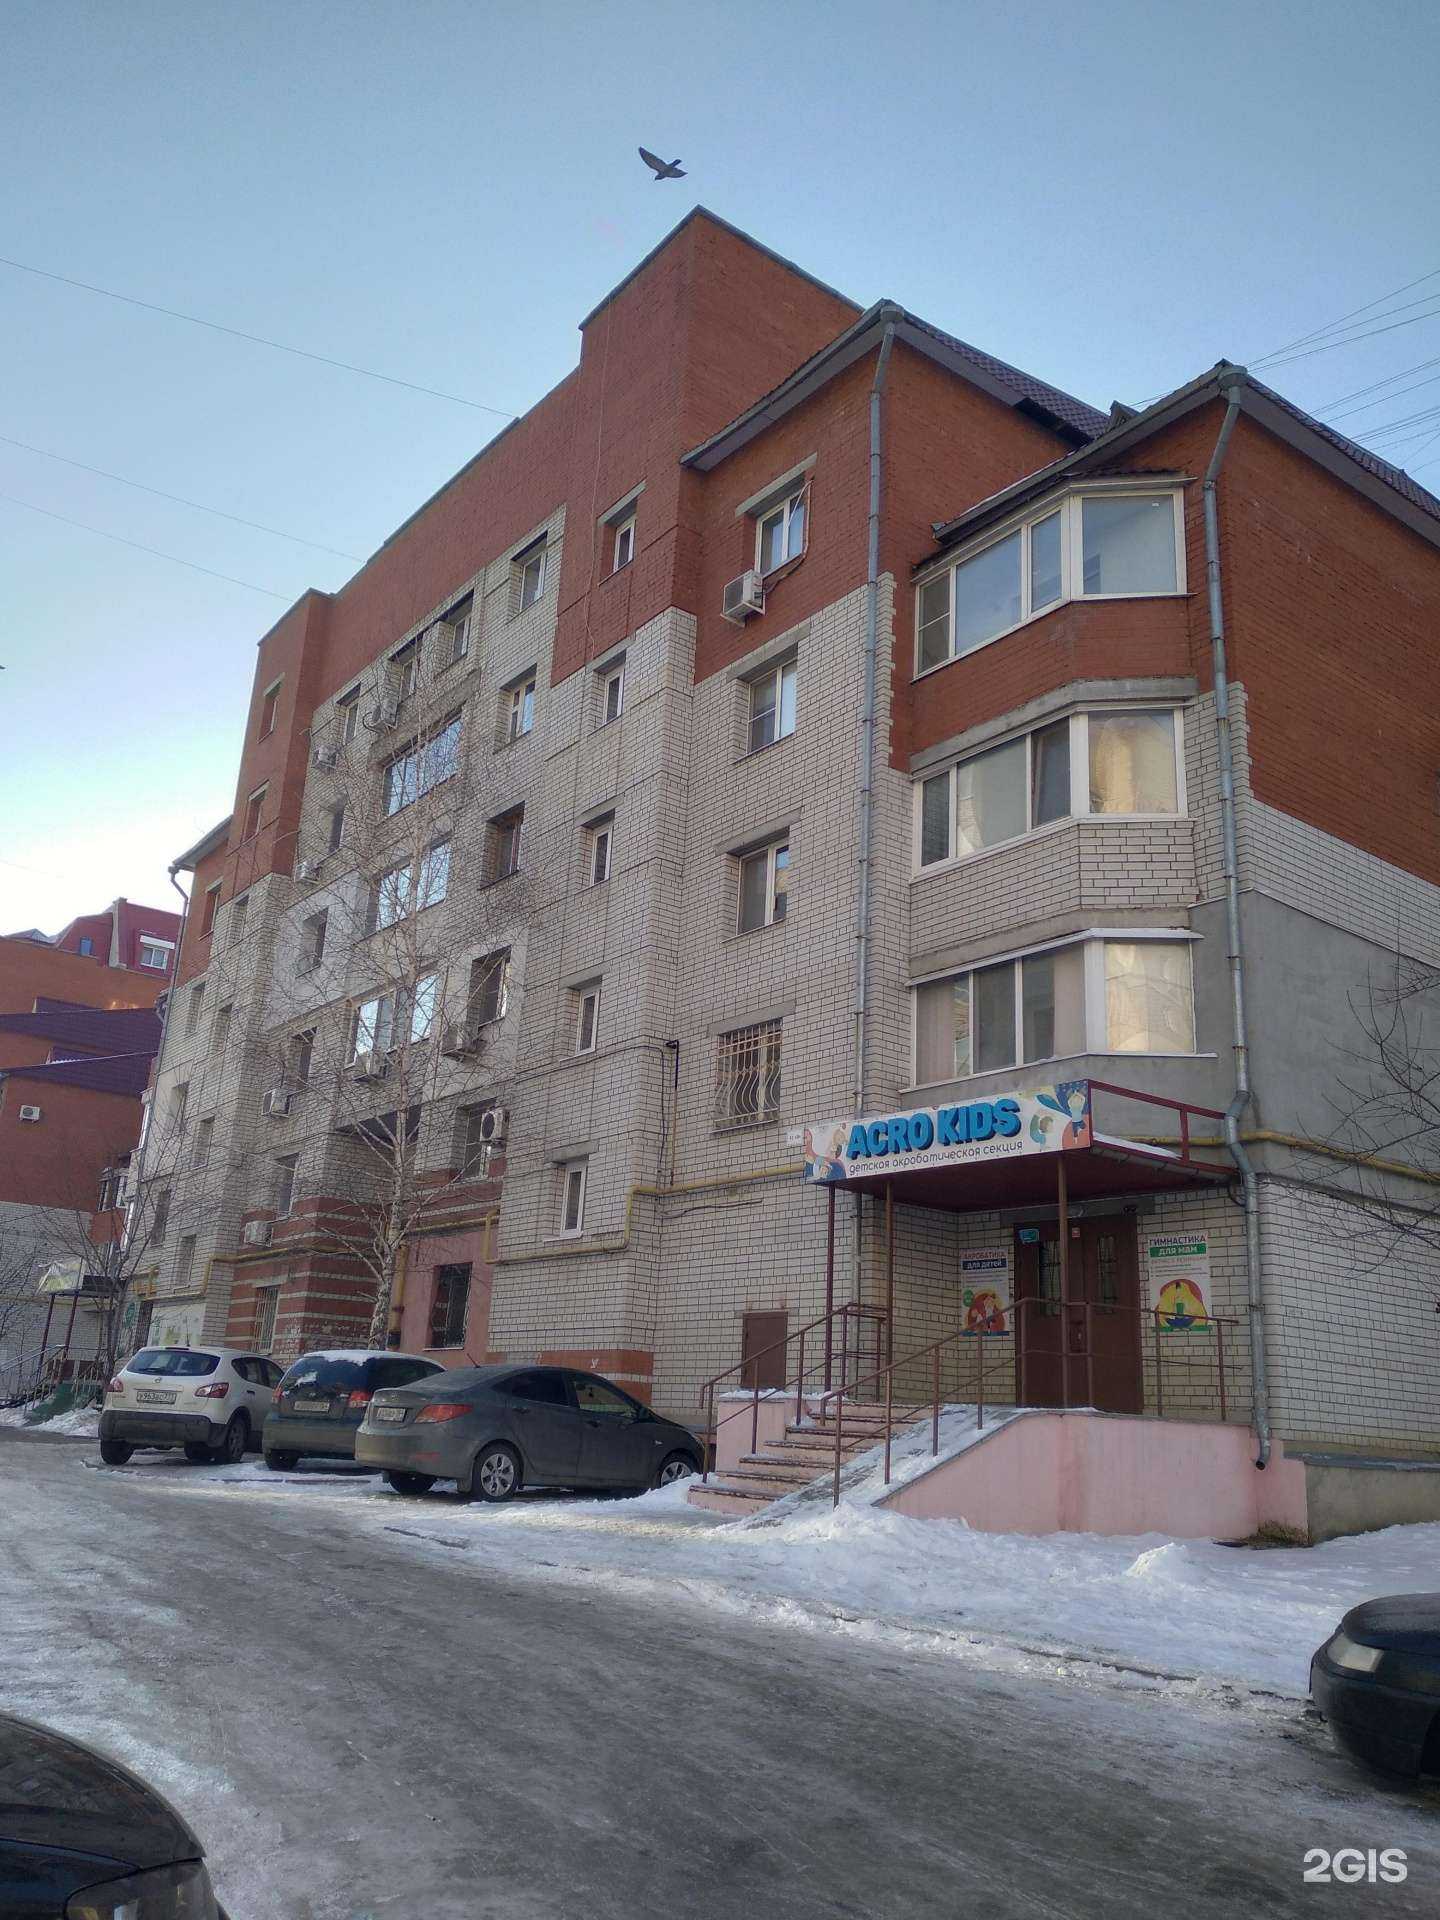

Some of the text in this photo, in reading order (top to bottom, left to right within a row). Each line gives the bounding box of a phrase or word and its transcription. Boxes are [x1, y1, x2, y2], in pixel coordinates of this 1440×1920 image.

[847, 1098, 1021, 1160] ACRO KIDS
[849, 1140, 1023, 1176] детская акробатическая секция
[1150, 1235, 1206, 1247] ГИМНАСТИКА
